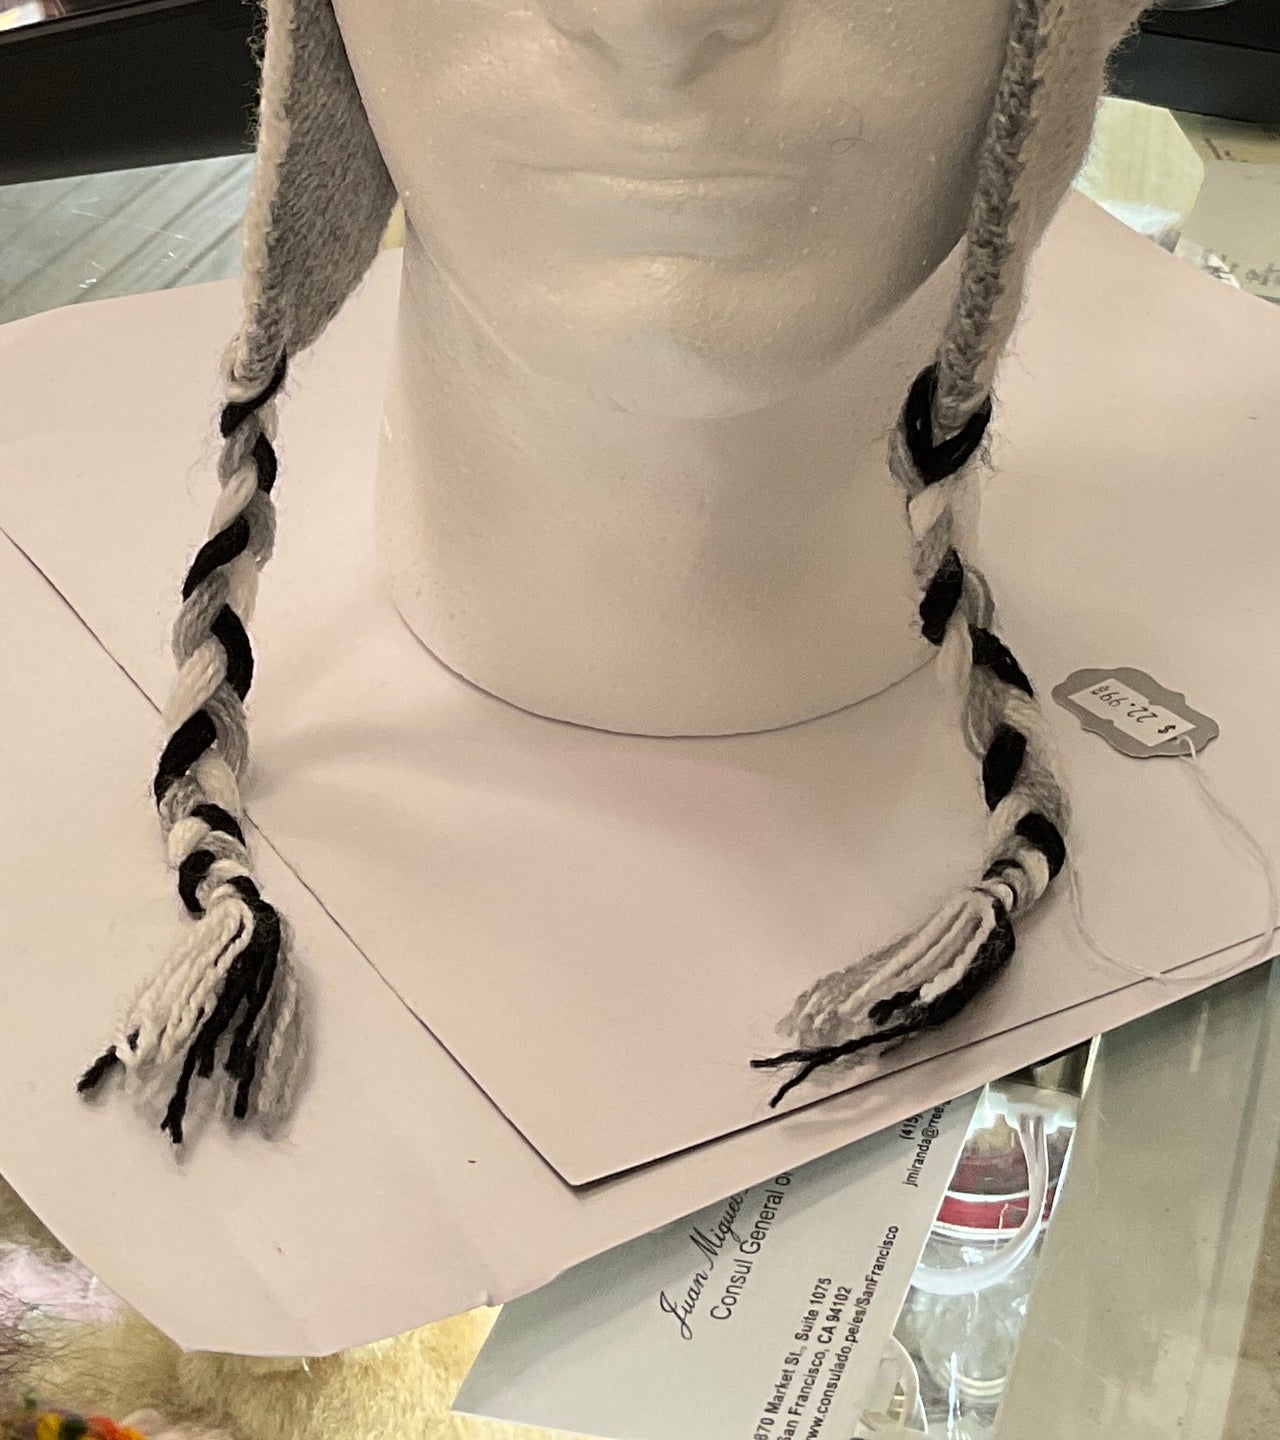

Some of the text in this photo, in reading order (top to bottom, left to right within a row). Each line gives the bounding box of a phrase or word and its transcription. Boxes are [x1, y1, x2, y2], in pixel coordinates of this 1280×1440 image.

[660, 1271, 709, 1340] Juan
[710, 1260, 753, 1320] Consul
[740, 1188, 785, 1254] General
[765, 1369, 795, 1415] Market
[795, 1300, 819, 1341] Suite
[810, 1278, 832, 1304] 1075
[788, 1348, 830, 1417] Francisco,
[817, 1326, 836, 1345] CA
[827, 1286, 851, 1325] 94102
